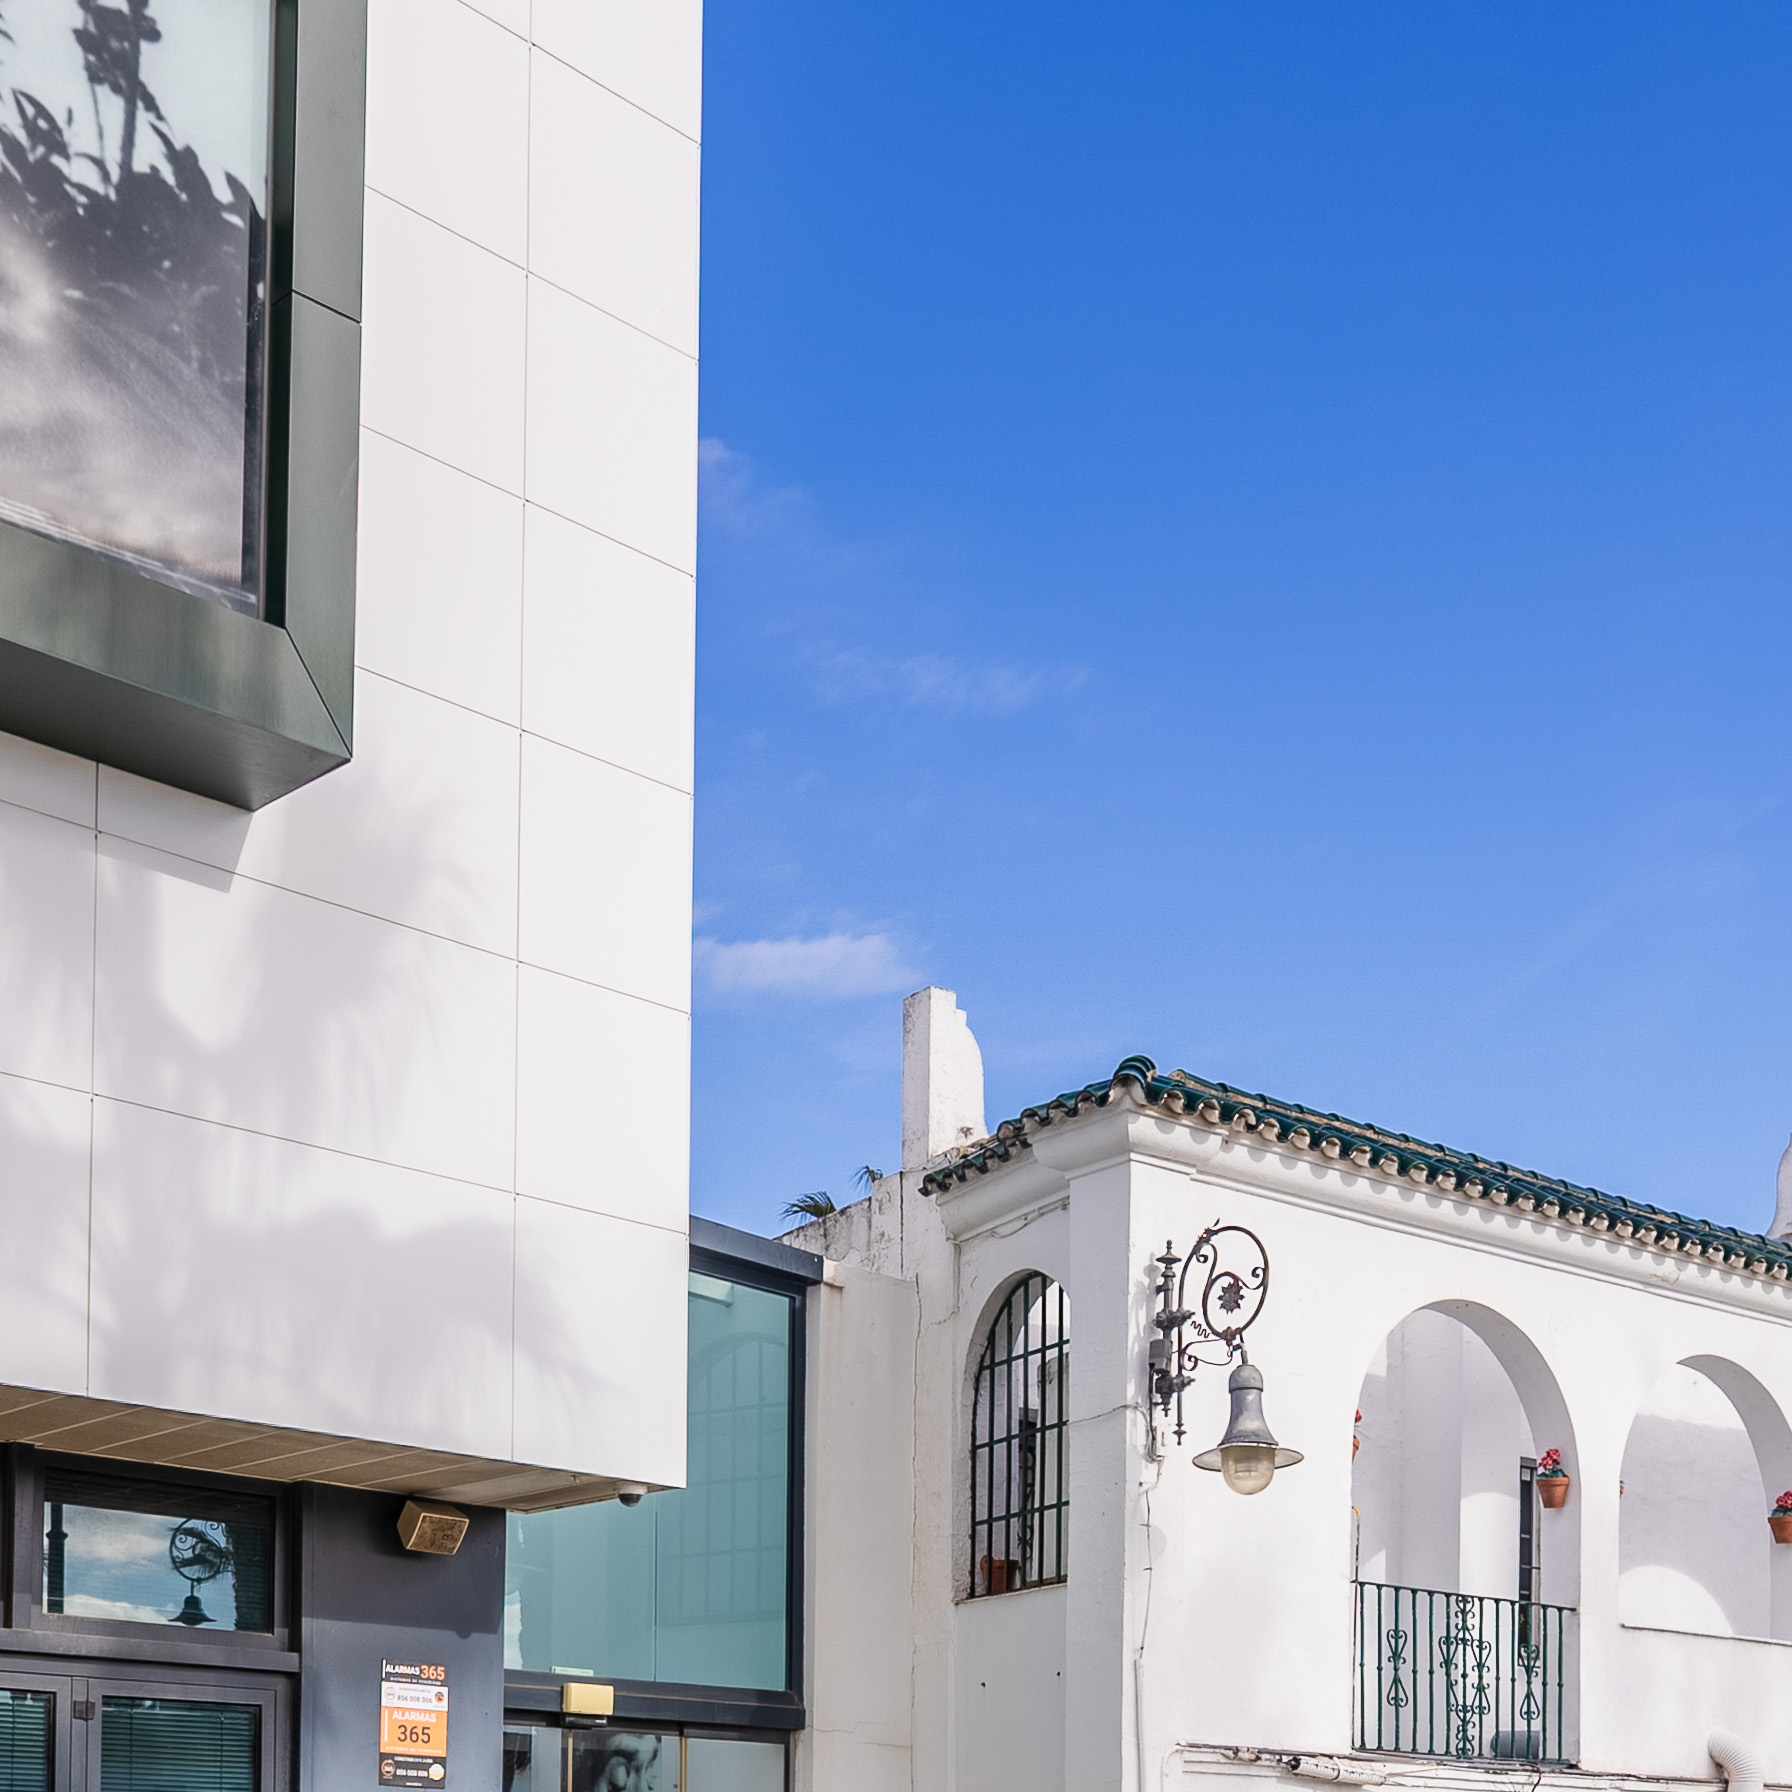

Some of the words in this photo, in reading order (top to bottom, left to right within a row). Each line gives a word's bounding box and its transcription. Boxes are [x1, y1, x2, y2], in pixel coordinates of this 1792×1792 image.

[385, 1664, 420, 1676] ALARMAS
[420, 1664, 446, 1681] 365
[392, 1710, 437, 1723] ALARMAS
[397, 1724, 431, 1744] 365
